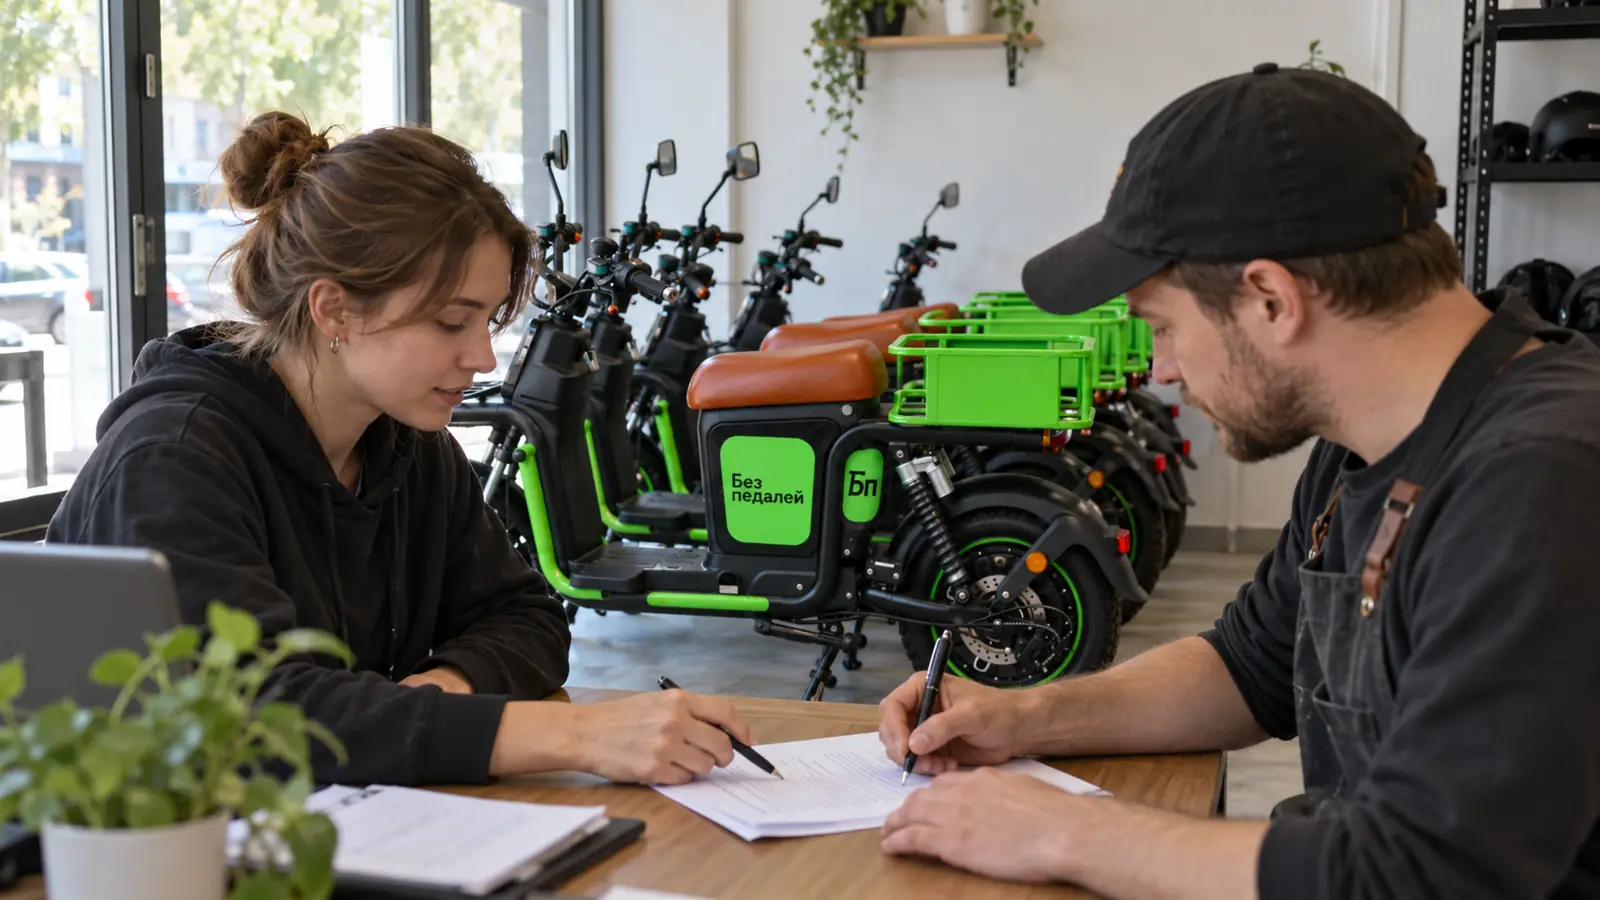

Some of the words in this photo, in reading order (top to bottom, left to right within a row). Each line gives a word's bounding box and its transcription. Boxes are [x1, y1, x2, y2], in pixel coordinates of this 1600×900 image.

[731, 473, 762, 489] Без
[848, 471, 878, 496] Бп
[731, 490, 804, 504] педалей
